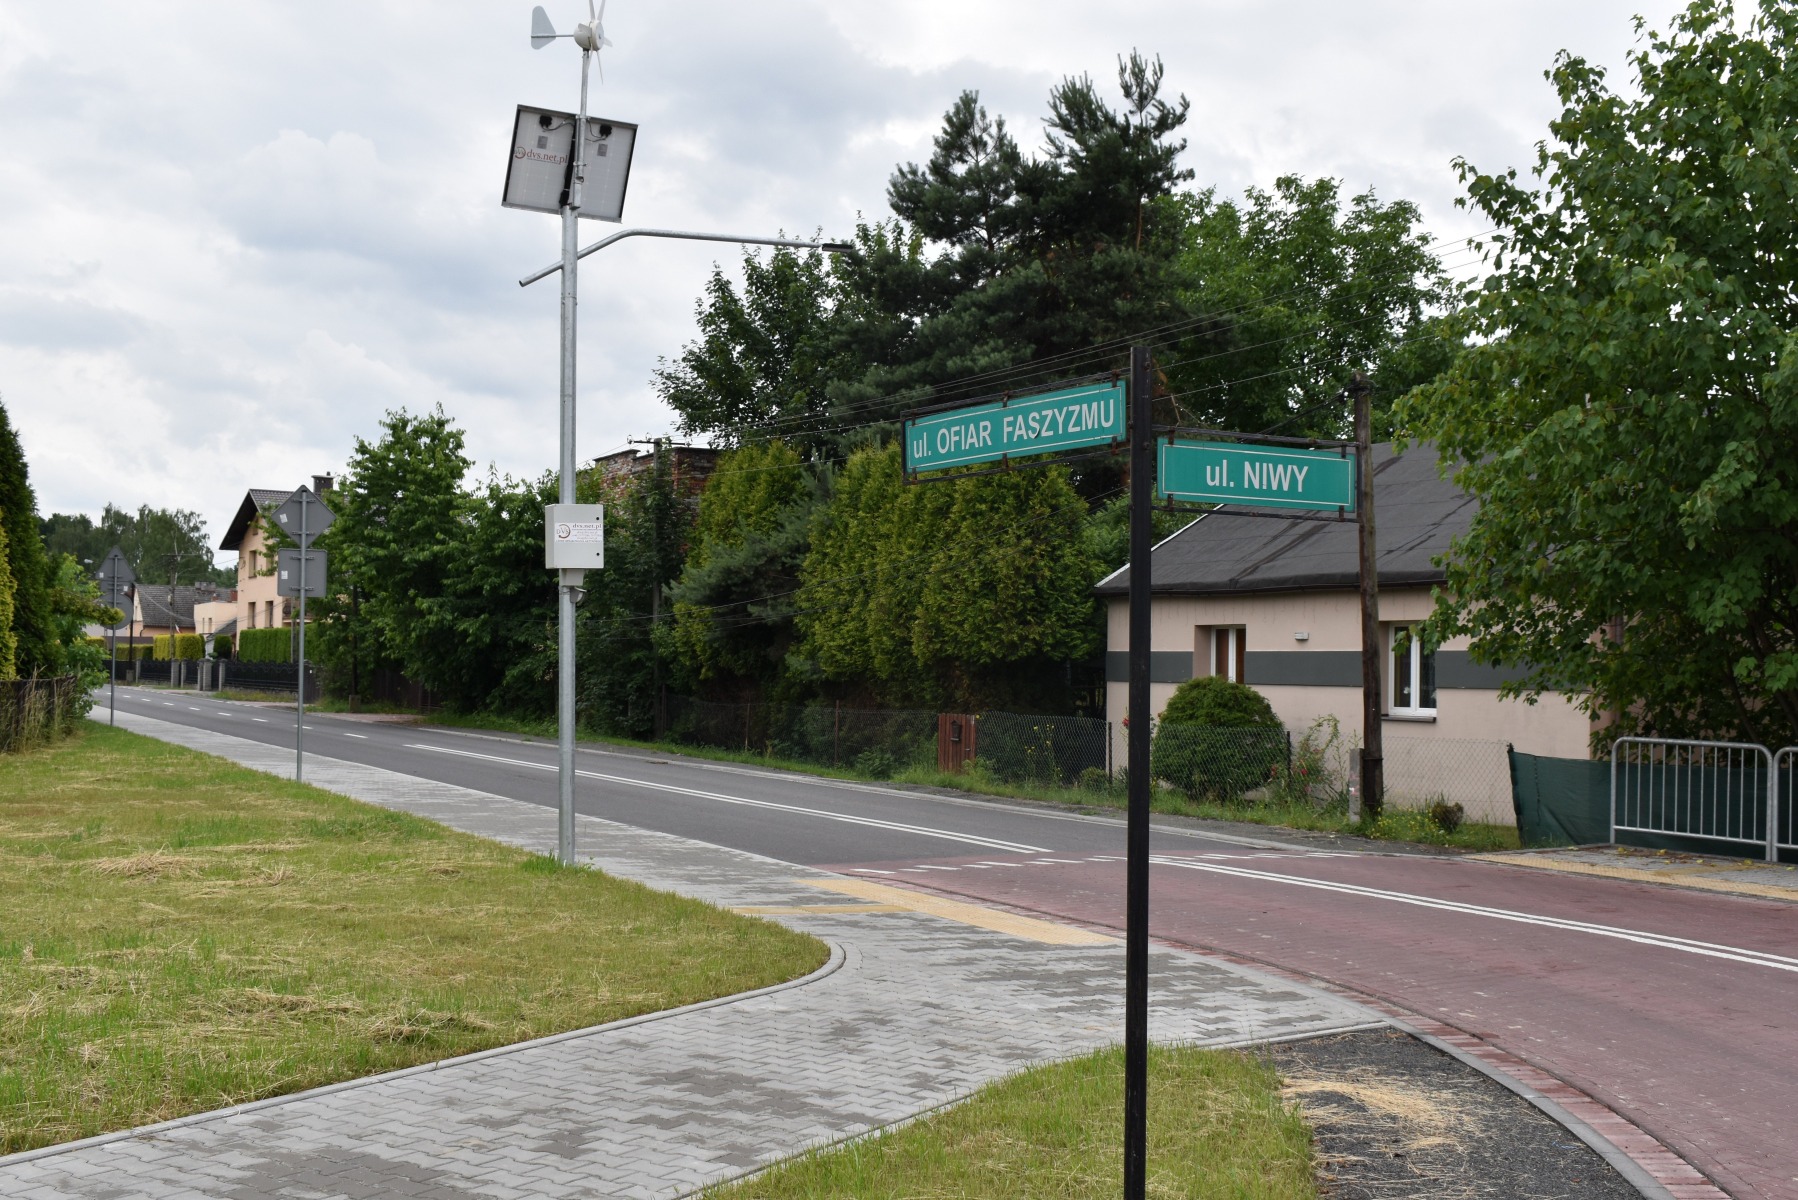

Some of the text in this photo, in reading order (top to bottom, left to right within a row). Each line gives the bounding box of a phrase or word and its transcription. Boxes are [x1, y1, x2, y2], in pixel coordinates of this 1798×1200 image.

[526, 149, 568, 164] dvs.net.pl
[913, 399, 1115, 459] ul. OFIAR FASZYZMU
[1206, 459, 1309, 492] ul. NIWY
